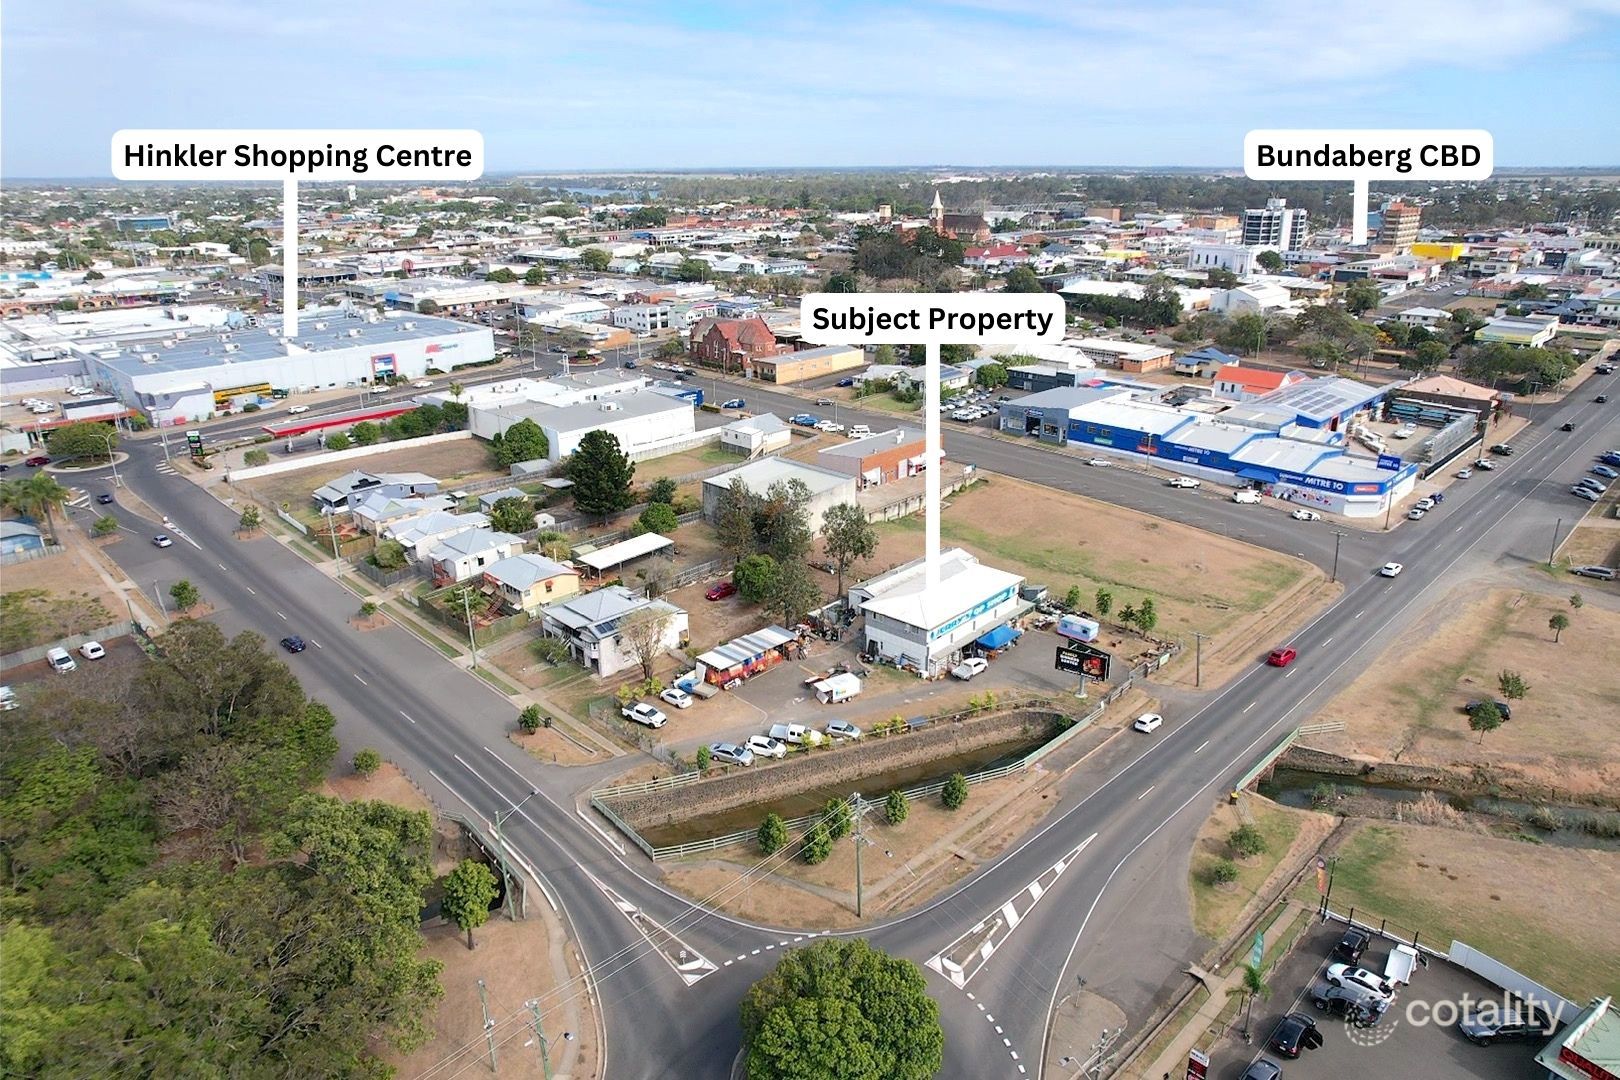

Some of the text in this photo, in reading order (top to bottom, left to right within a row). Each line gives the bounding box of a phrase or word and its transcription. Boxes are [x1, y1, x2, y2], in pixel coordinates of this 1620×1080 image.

[1304, 476, 1331, 489] MITRE
[1333, 480, 1344, 491] 10
[1562, 1048, 1616, 1080] QUALIT
